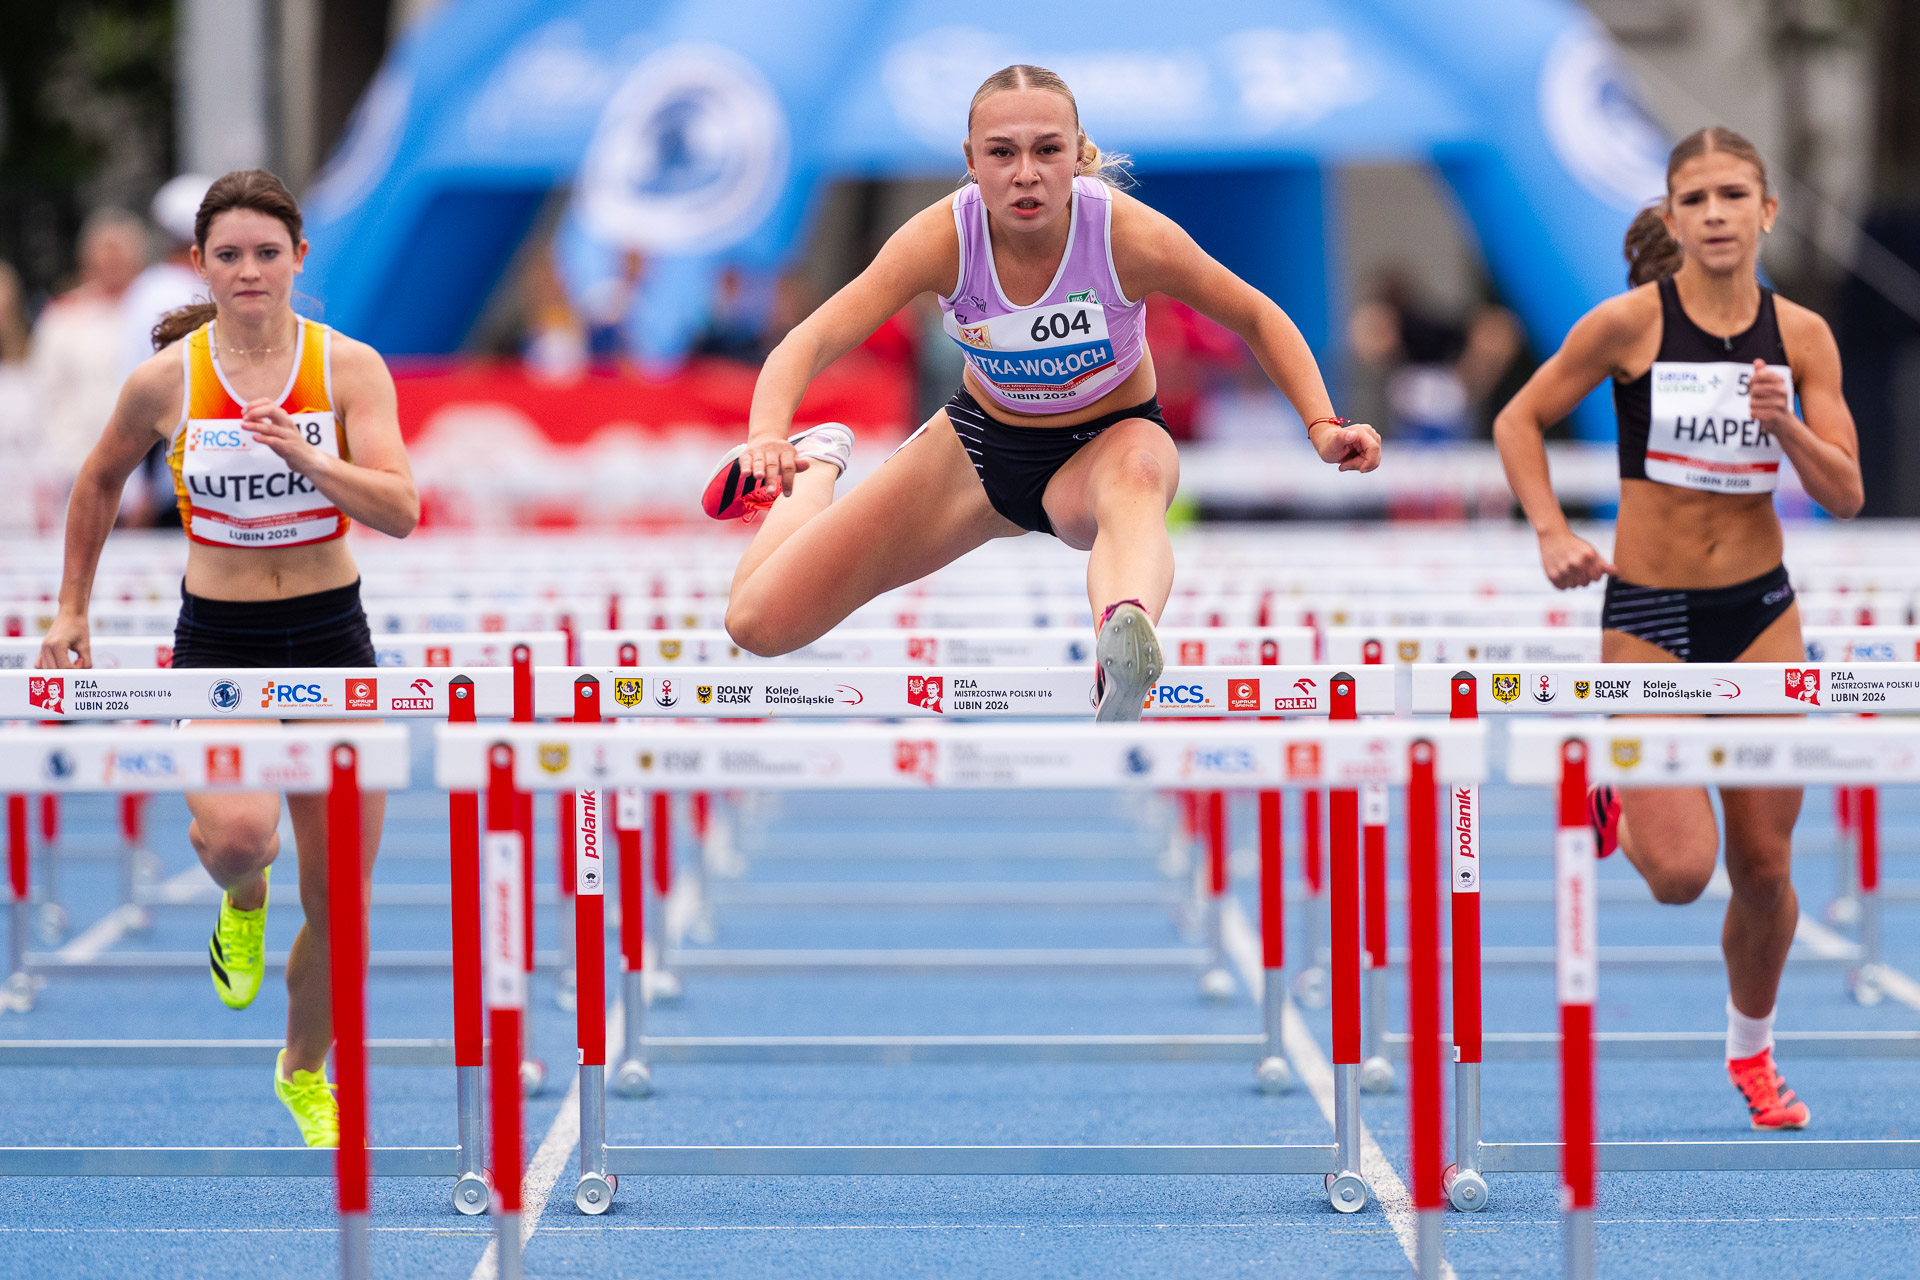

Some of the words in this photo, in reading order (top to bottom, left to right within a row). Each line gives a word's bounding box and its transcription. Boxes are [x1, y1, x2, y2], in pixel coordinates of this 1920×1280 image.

[1031, 310, 1091, 341] 604
[1001, 391, 1040, 400] LUBIN
[1043, 391, 1077, 400] 2026
[229, 529, 264, 541] LUBIN
[267, 527, 297, 540] 2026
[1831, 671, 1854, 680] PZLA
[75, 680, 98, 689] PZLA
[954, 679, 978, 688] PZLA
[1595, 680, 1631, 689] DOLNY
[1643, 680, 1677, 690] Koleje
[75, 690, 127, 698] MISTRZOSTWA
[717, 686, 753, 694] DOLNY
[765, 686, 799, 696] Koleje
[954, 690, 1007, 698] MISTRZOSTWA
[1643, 689, 1712, 699] Dolnośląskie
[765, 695, 835, 705] Dolnośląskie
[1831, 693, 1859, 702] LUBIN
[1862, 692, 1886, 701] 2026
[75, 701, 103, 710] LUBIN
[105, 701, 129, 710] 2026
[393, 699, 433, 709] ORLEN
[954, 701, 982, 710] LUBIN
[985, 701, 1009, 710] 2026
[1276, 698, 1316, 709] ORLEN
[580, 789, 600, 859] polanik
[1455, 787, 1475, 859] polanik
